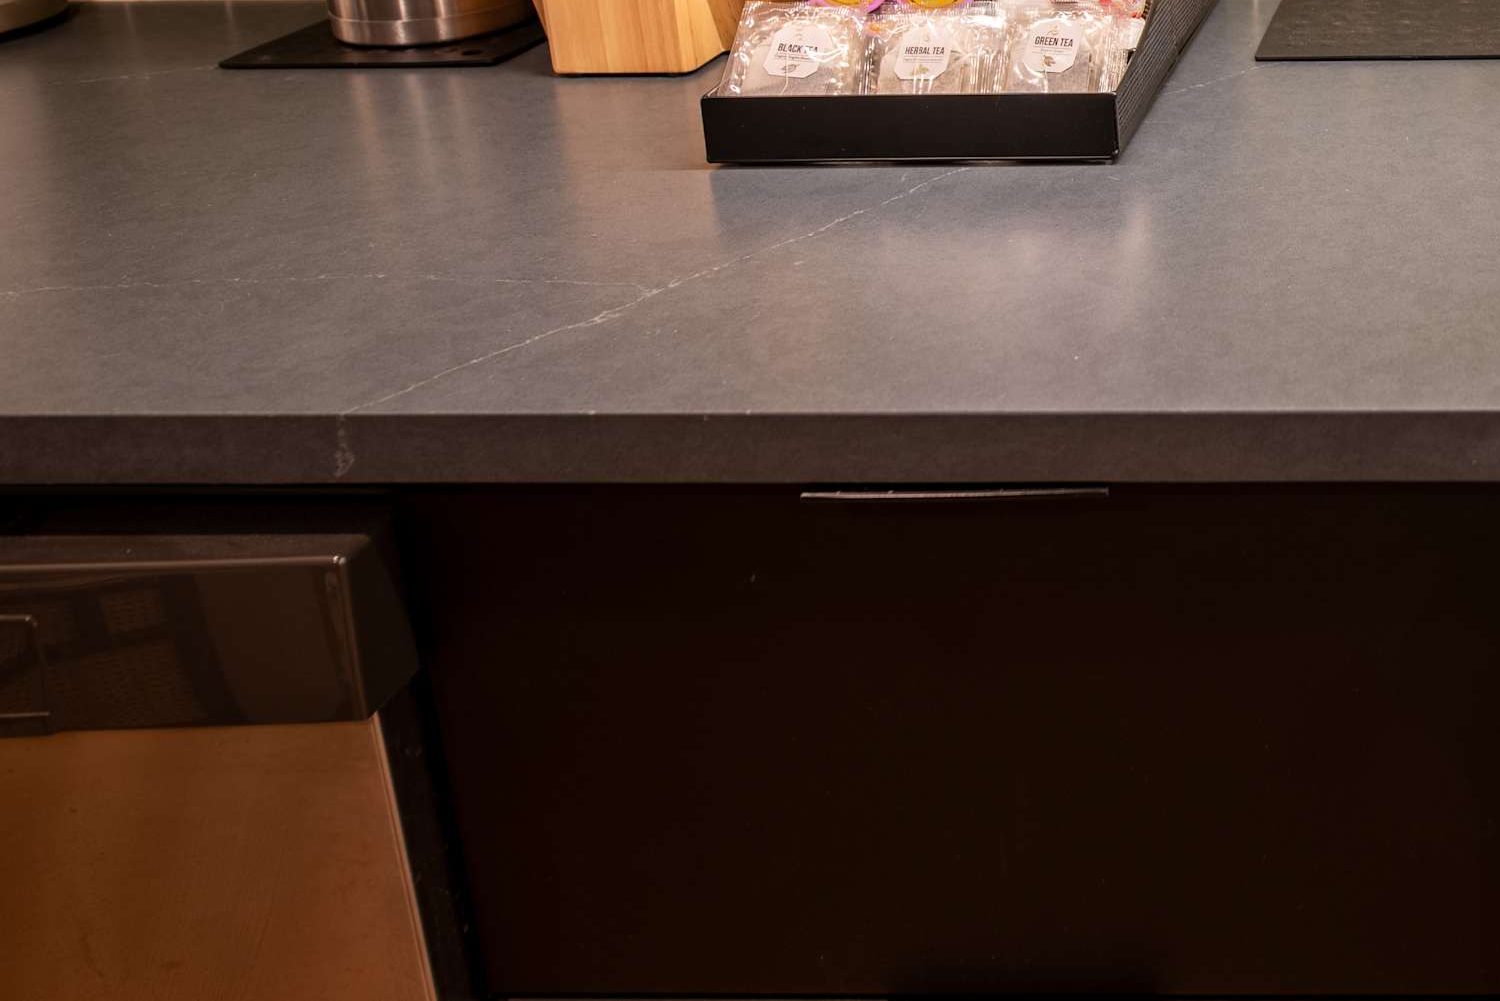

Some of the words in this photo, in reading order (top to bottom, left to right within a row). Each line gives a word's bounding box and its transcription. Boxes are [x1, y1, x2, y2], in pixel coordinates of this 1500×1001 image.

[1034, 35, 1059, 46] GREEN
[1060, 37, 1074, 47] TEA
[777, 42, 803, 54] BLACK
[904, 46, 931, 55] HERBAL
[932, 46, 945, 55] TEA
